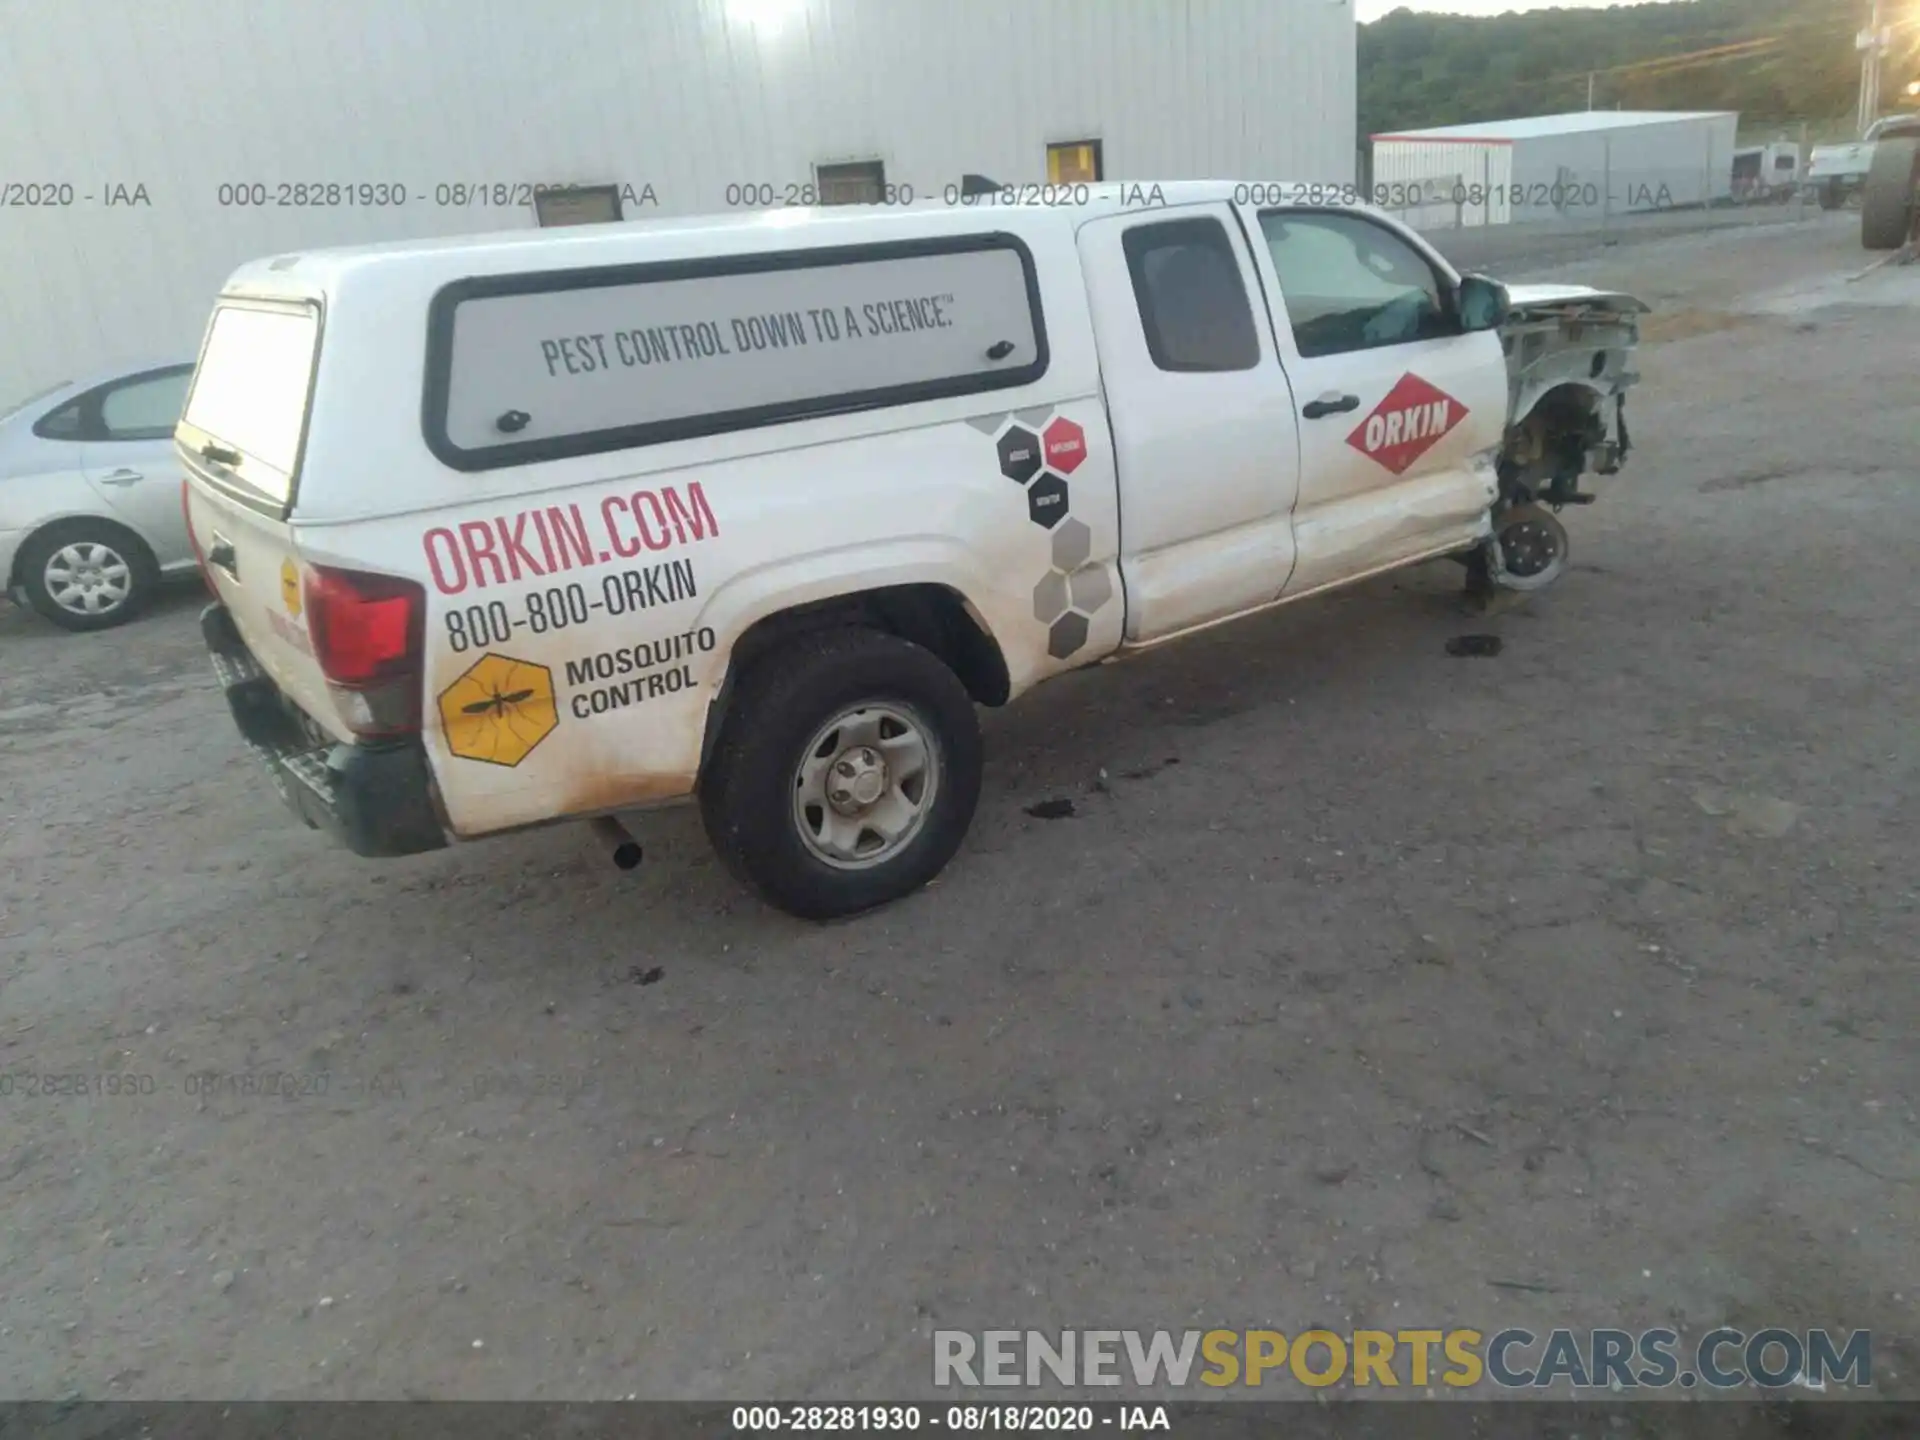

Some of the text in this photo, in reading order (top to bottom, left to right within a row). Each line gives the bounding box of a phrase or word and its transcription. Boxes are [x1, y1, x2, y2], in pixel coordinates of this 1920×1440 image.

[541, 334, 609, 377] PEST
[615, 320, 730, 367] CONTROL
[731, 309, 807, 352] DOWN
[807, 307, 840, 343] TO
[845, 305, 862, 339] A
[1365, 399, 1449, 452] ORKIN
[422, 481, 719, 595] ORKIN.COM
[445, 558, 697, 653] 800-800-ORKIN
[565, 626, 716, 686] MOSQUITO
[571, 664, 698, 719] CONTROL
